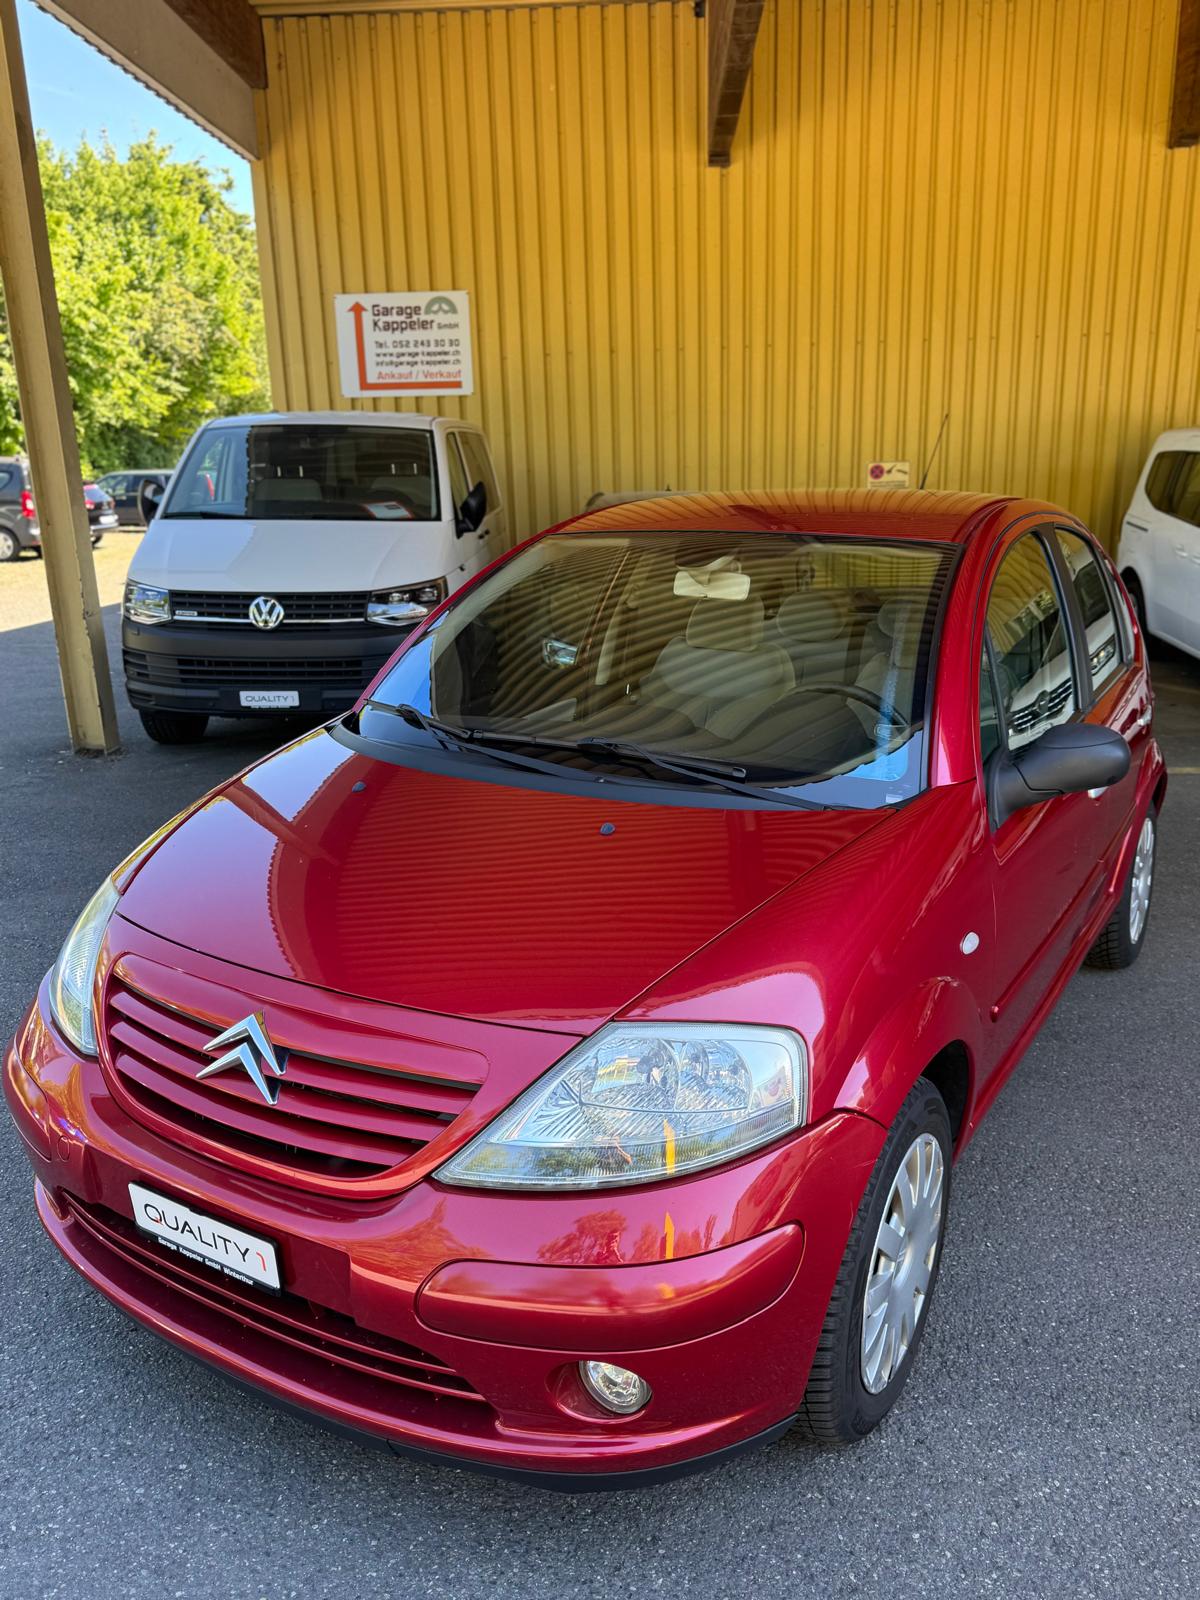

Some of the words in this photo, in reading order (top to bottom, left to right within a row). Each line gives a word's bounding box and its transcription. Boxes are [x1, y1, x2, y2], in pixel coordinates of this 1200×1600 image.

[371, 304, 422, 319] Garage
[372, 318, 434, 334] Kappeler
[374, 340, 390, 349] Tel.
[392, 340, 411, 348] 052
[413, 339, 431, 348] 243
[434, 339, 446, 347] 30
[449, 338, 460, 347] 30
[377, 370, 413, 380] Ankauf
[422, 369, 462, 379] Verkauf
[245, 695, 289, 703] QUALITY
[143, 1203, 250, 1263] QUALITY
[222, 1266, 254, 1286] Winterthur
